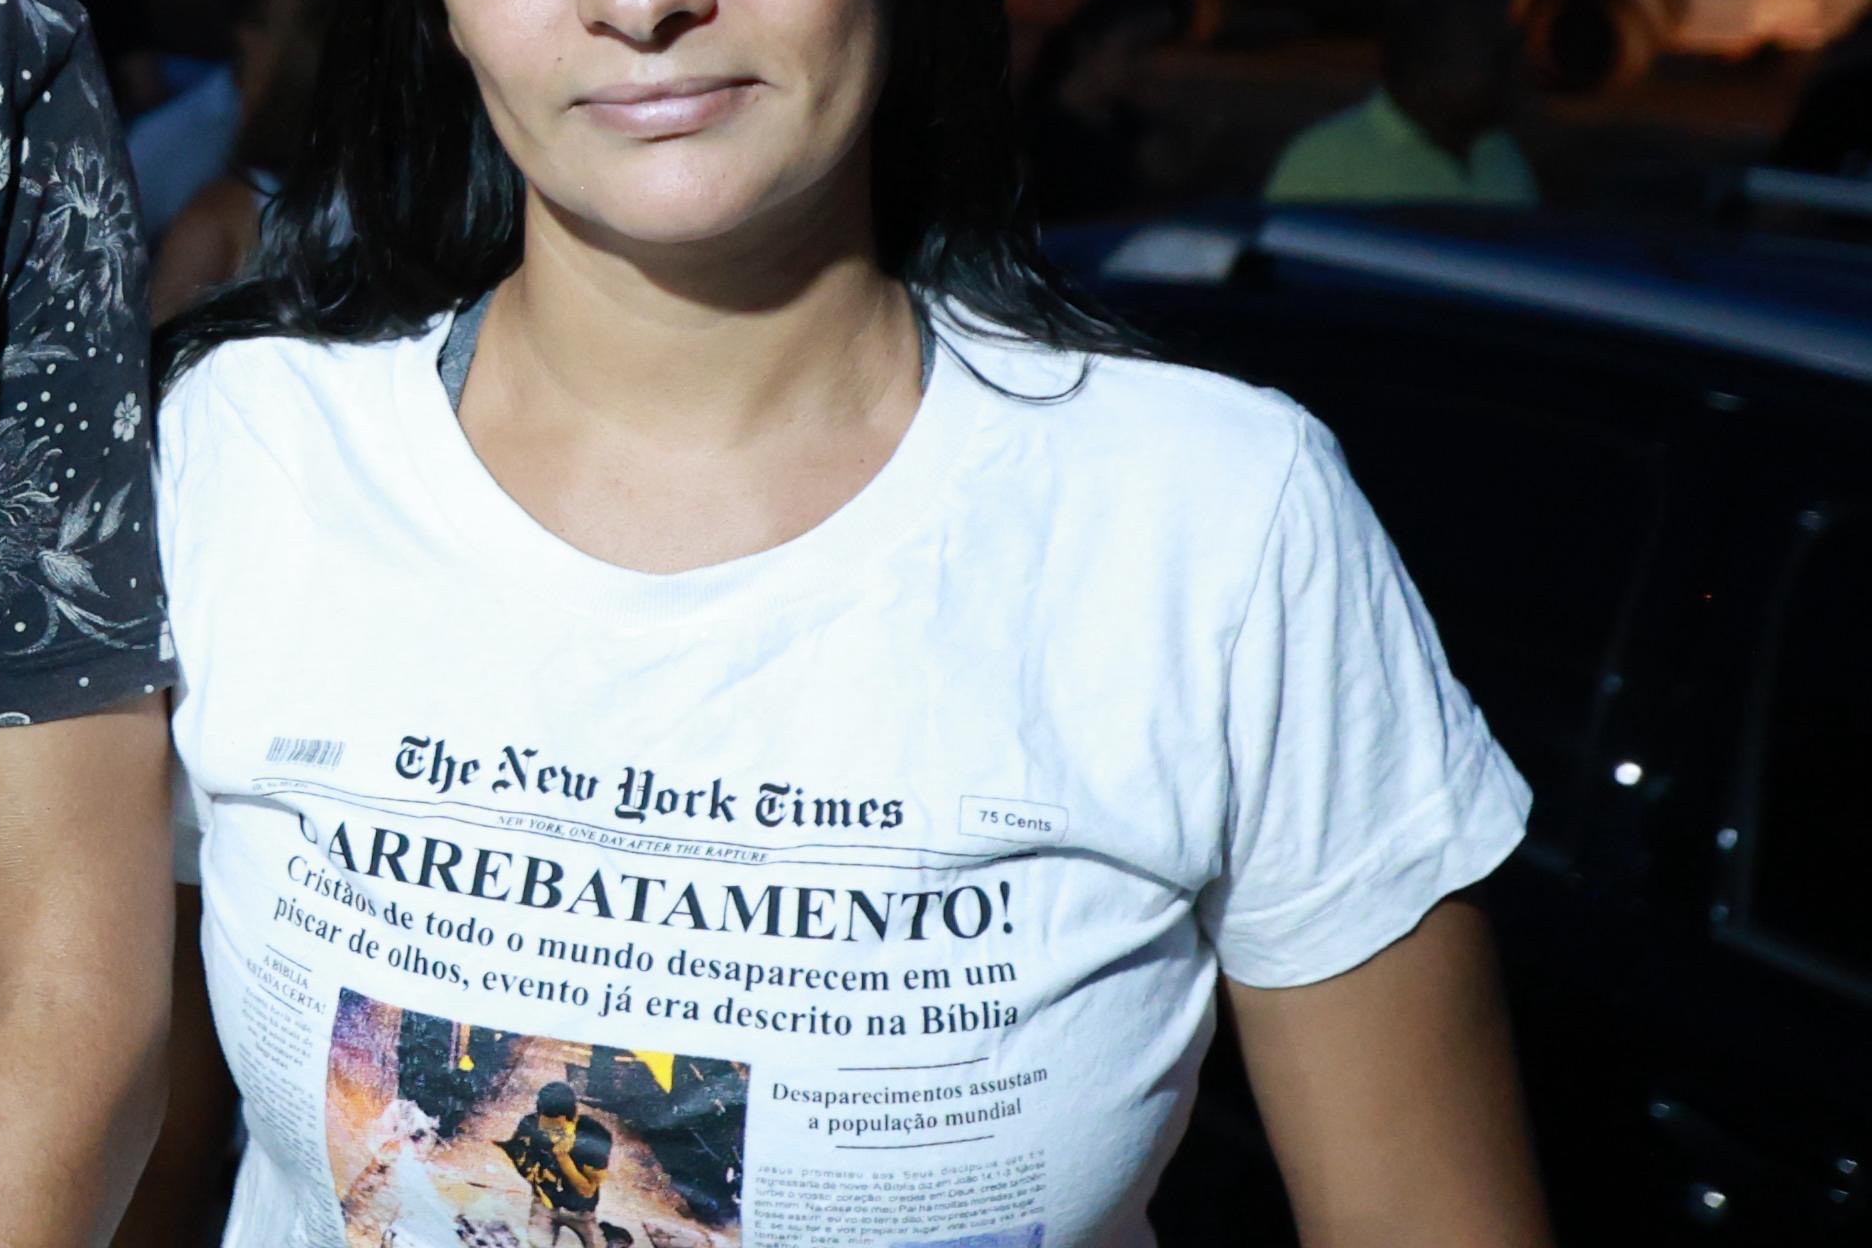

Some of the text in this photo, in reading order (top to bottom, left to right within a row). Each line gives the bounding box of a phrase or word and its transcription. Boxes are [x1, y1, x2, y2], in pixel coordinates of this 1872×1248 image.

[395, 735, 904, 829] The New York Times
[497, 815, 768, 863] NEW YORK, ONE DAY AFTER THE RAPTURE
[979, 810, 1052, 832] 75 Cents
[328, 821, 1015, 942] ARREBATAMENTO!
[288, 855, 1016, 991] Cristãos de todo o mundo desaparecem em um
[274, 896, 1019, 1036] piscar de olhos, evento já era descrito na Bíblia
[772, 1068, 1048, 1109] Desaparecimentos assustam
[809, 1098, 1021, 1135] a população mundial
